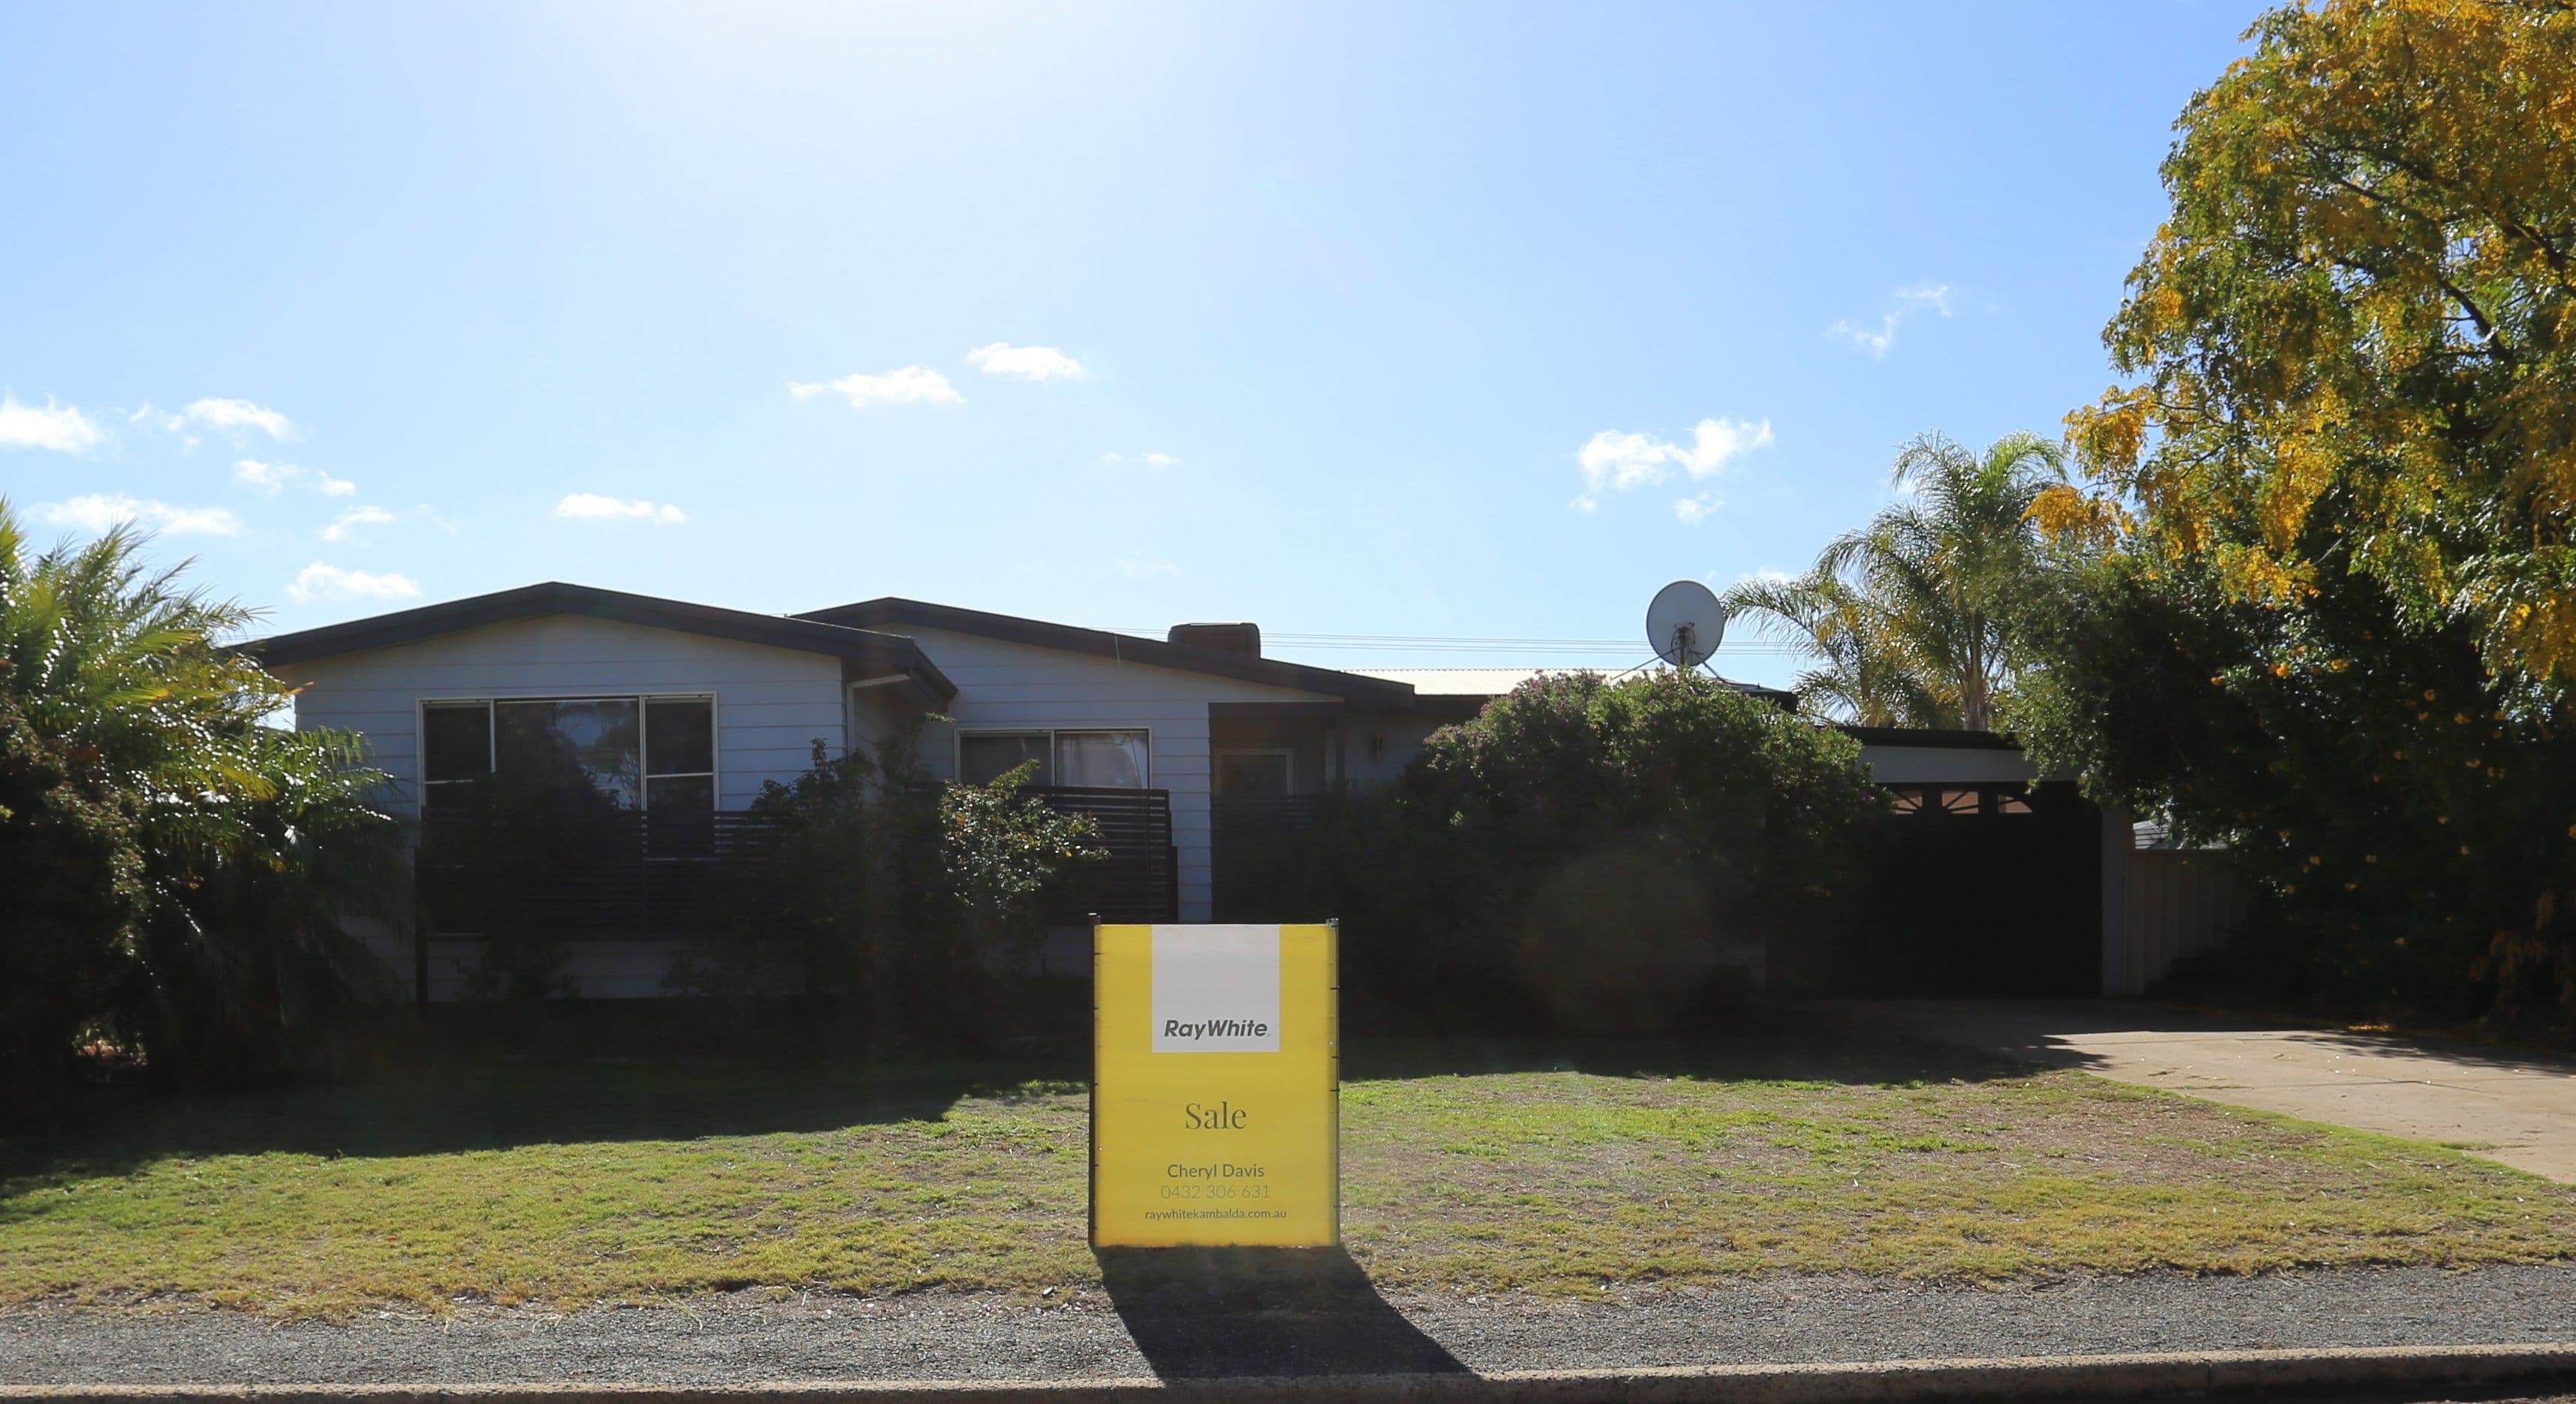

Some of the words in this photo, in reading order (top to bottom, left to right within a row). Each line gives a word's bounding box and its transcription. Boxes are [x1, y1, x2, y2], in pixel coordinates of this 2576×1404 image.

[1185, 1101, 1247, 1129] Sale
[1167, 1164, 1217, 1180] Cheryl
[1223, 1164, 1265, 1177] Davis
[1160, 1185, 1201, 1199] 0432
[1207, 1185, 1236, 1199] 306
[1241, 1184, 1269, 1198] 631
[1145, 1209, 1286, 1221] raywhitekambalda.com.au
